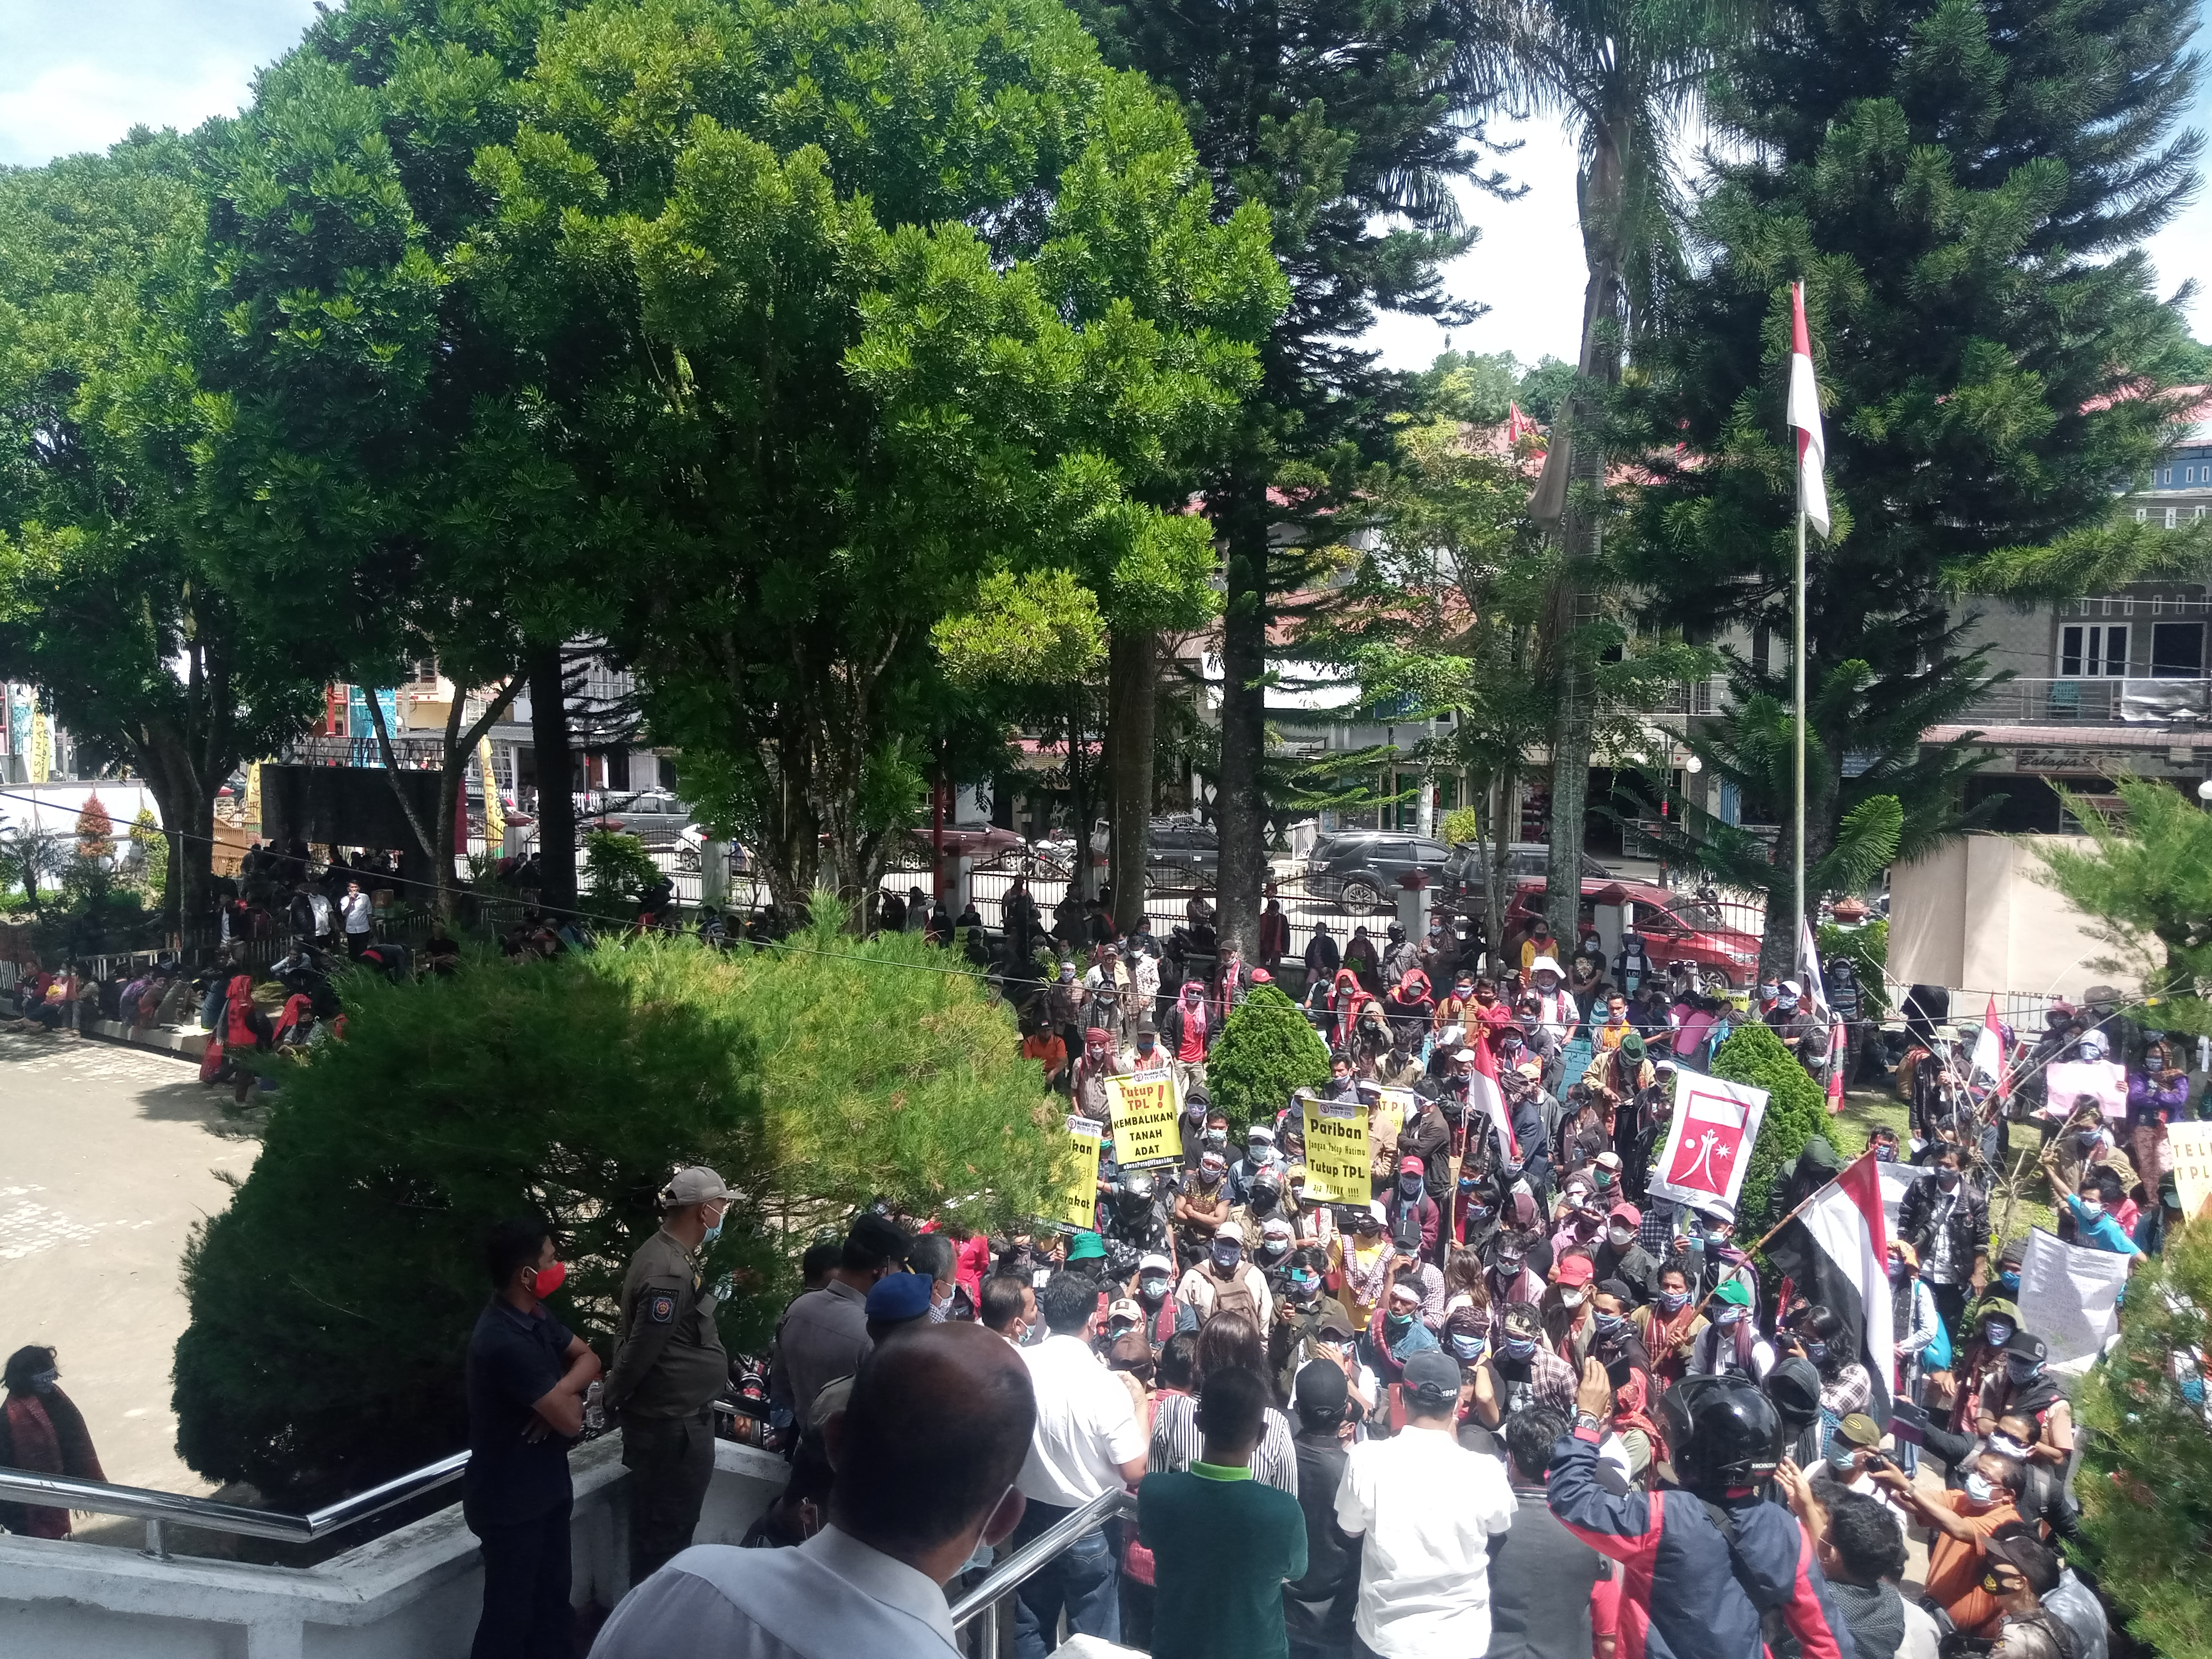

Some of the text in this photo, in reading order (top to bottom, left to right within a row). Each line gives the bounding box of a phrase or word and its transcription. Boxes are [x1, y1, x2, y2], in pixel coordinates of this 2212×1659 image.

[1120, 1086, 1153, 1097] Tutup
[1127, 1099, 1150, 1111] TPL
[1113, 1112, 1174, 1129] KEMBALIKAN
[1129, 1129, 1162, 1141] TANAH
[1310, 1118, 1361, 1139] Pariban
[1135, 1144, 1160, 1157] ADAT
[1309, 1139, 1326, 1152] Jangan
[1345, 1145, 1365, 1155] Hatimu
[1310, 1159, 1365, 1178] Tutup TPL
[2177, 1165, 2209, 1180] TPL
[1313, 1183, 1322, 1194] aja
[1442, 1388, 1457, 1397] 1994
